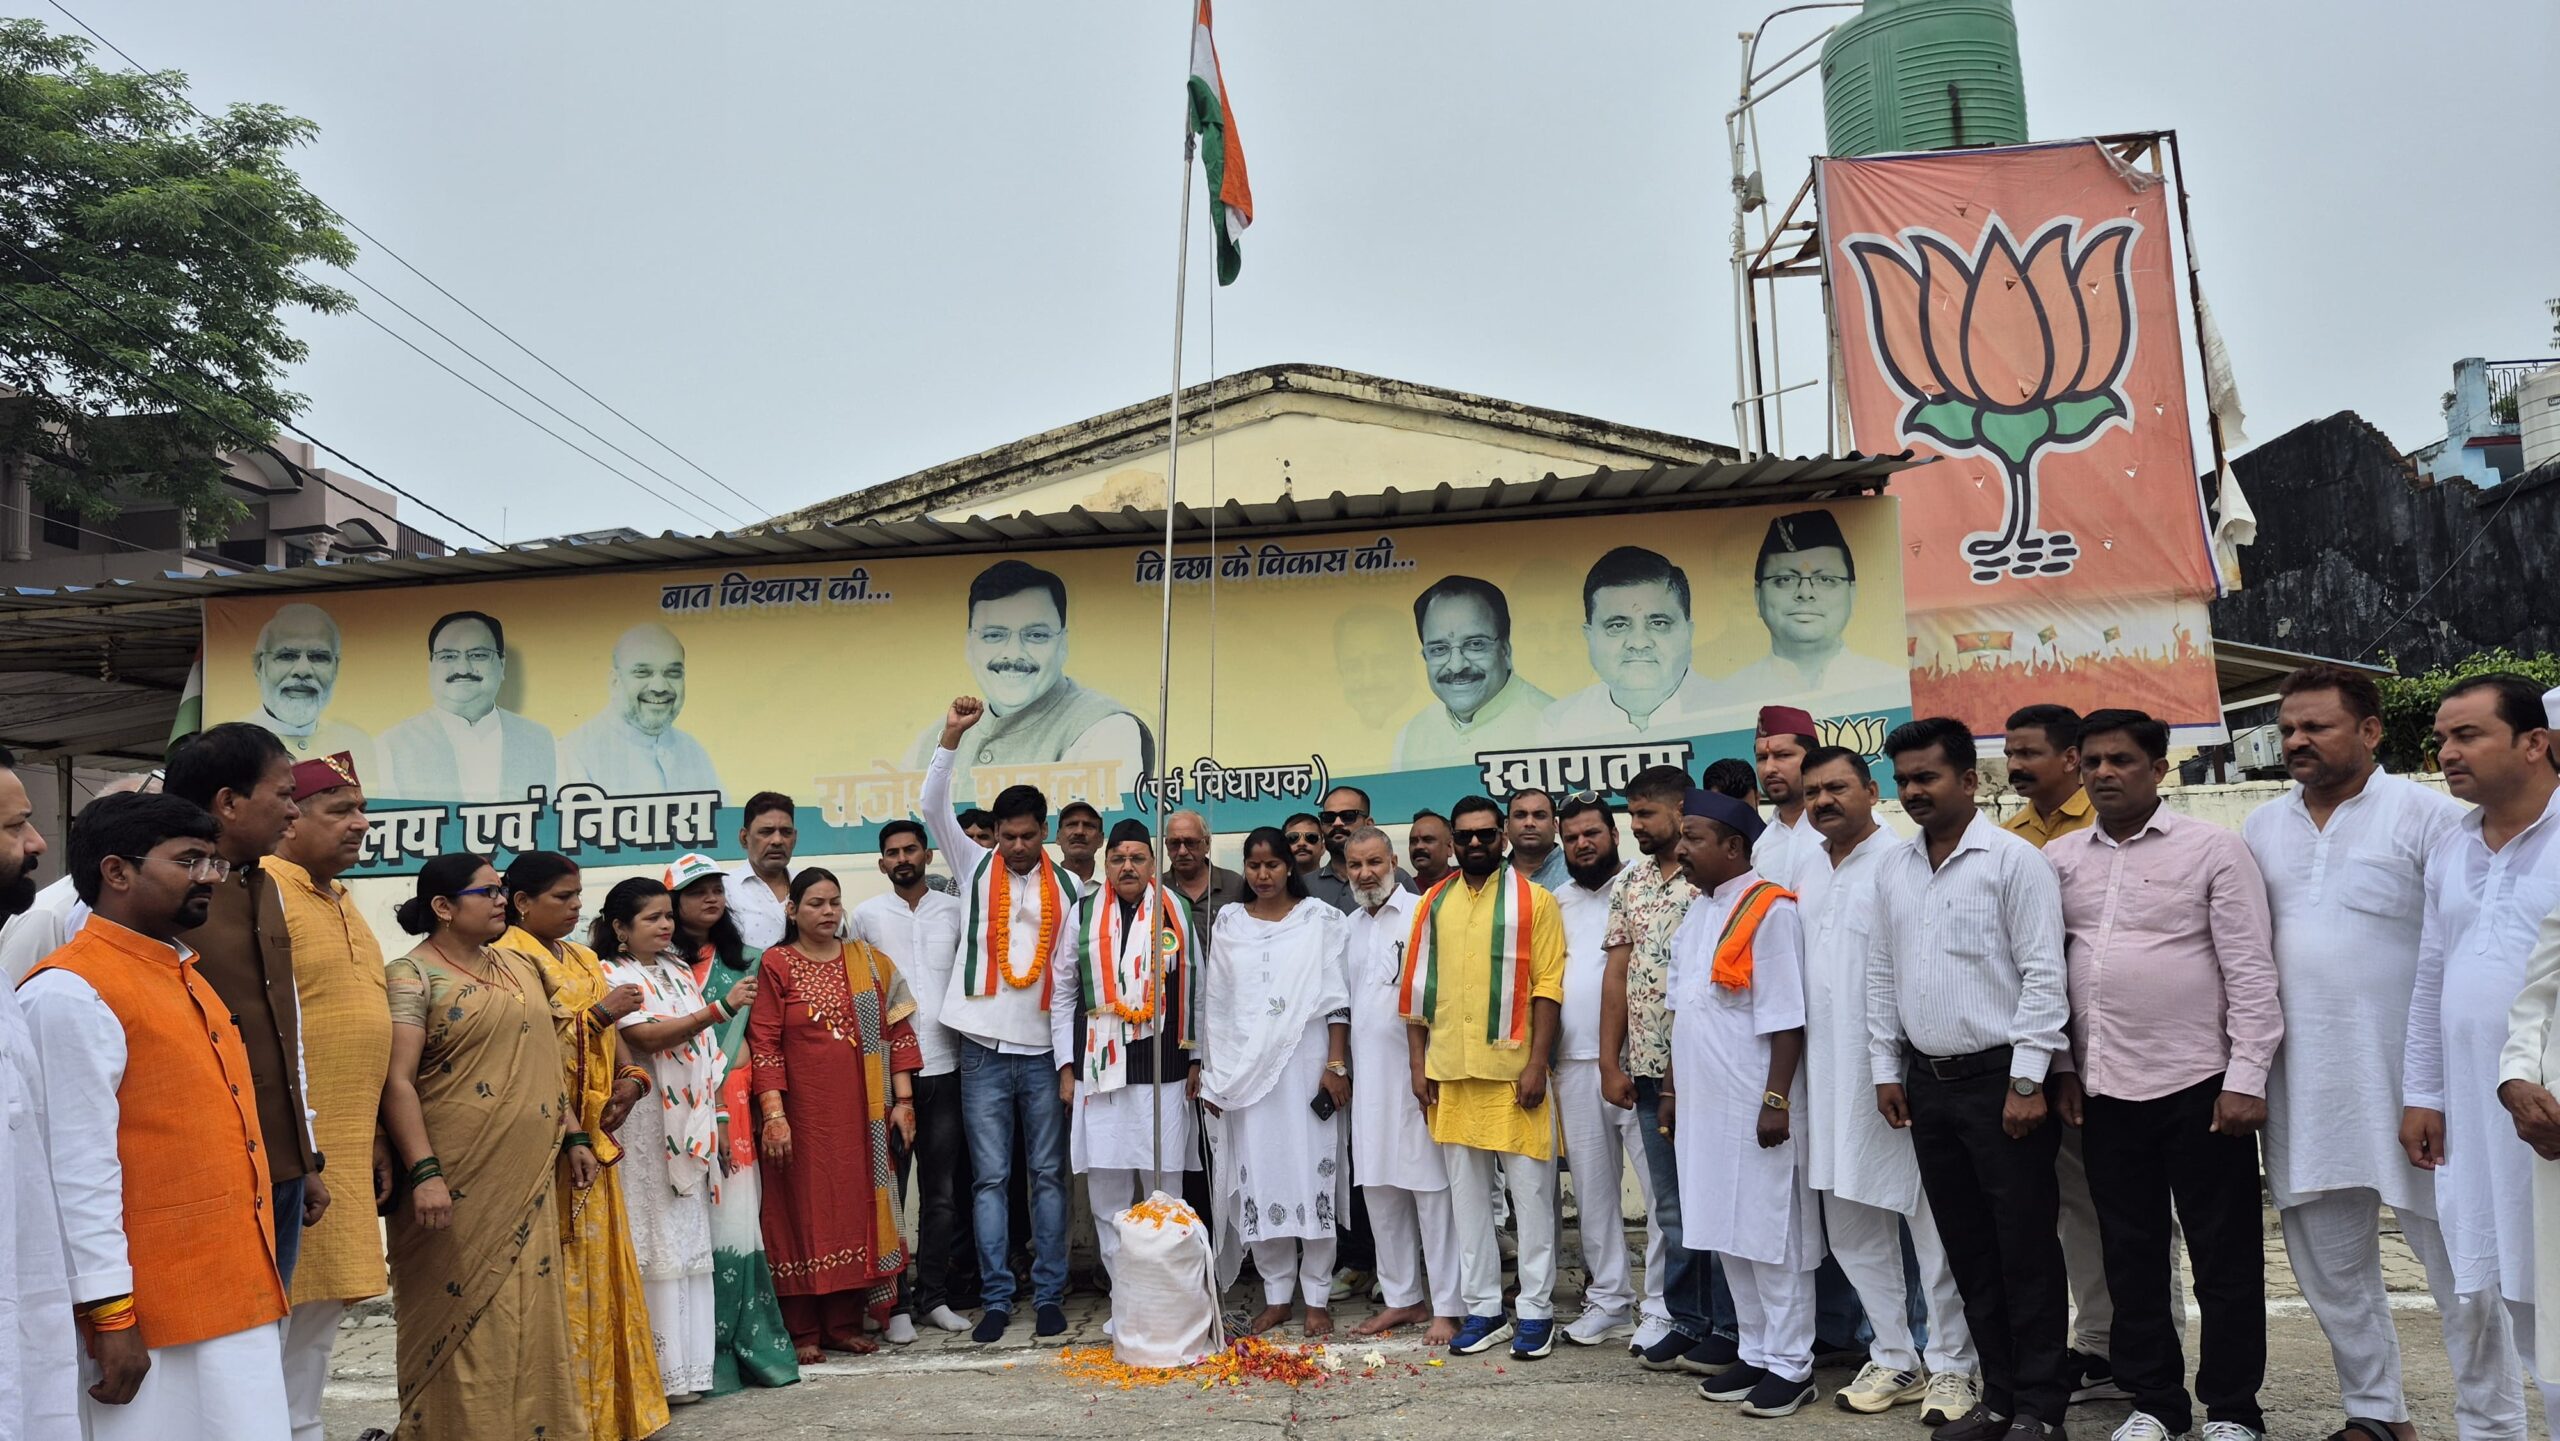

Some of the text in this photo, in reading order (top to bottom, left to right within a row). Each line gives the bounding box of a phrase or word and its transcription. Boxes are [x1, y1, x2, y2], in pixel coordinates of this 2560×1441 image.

[1221, 545, 1252, 578] के
[1257, 544, 1350, 577] विकास
[661, 583, 714, 610] बात
[719, 571, 823, 606] विश्वास
[456, 784, 548, 857] एवं
[552, 783, 722, 855] निवास
